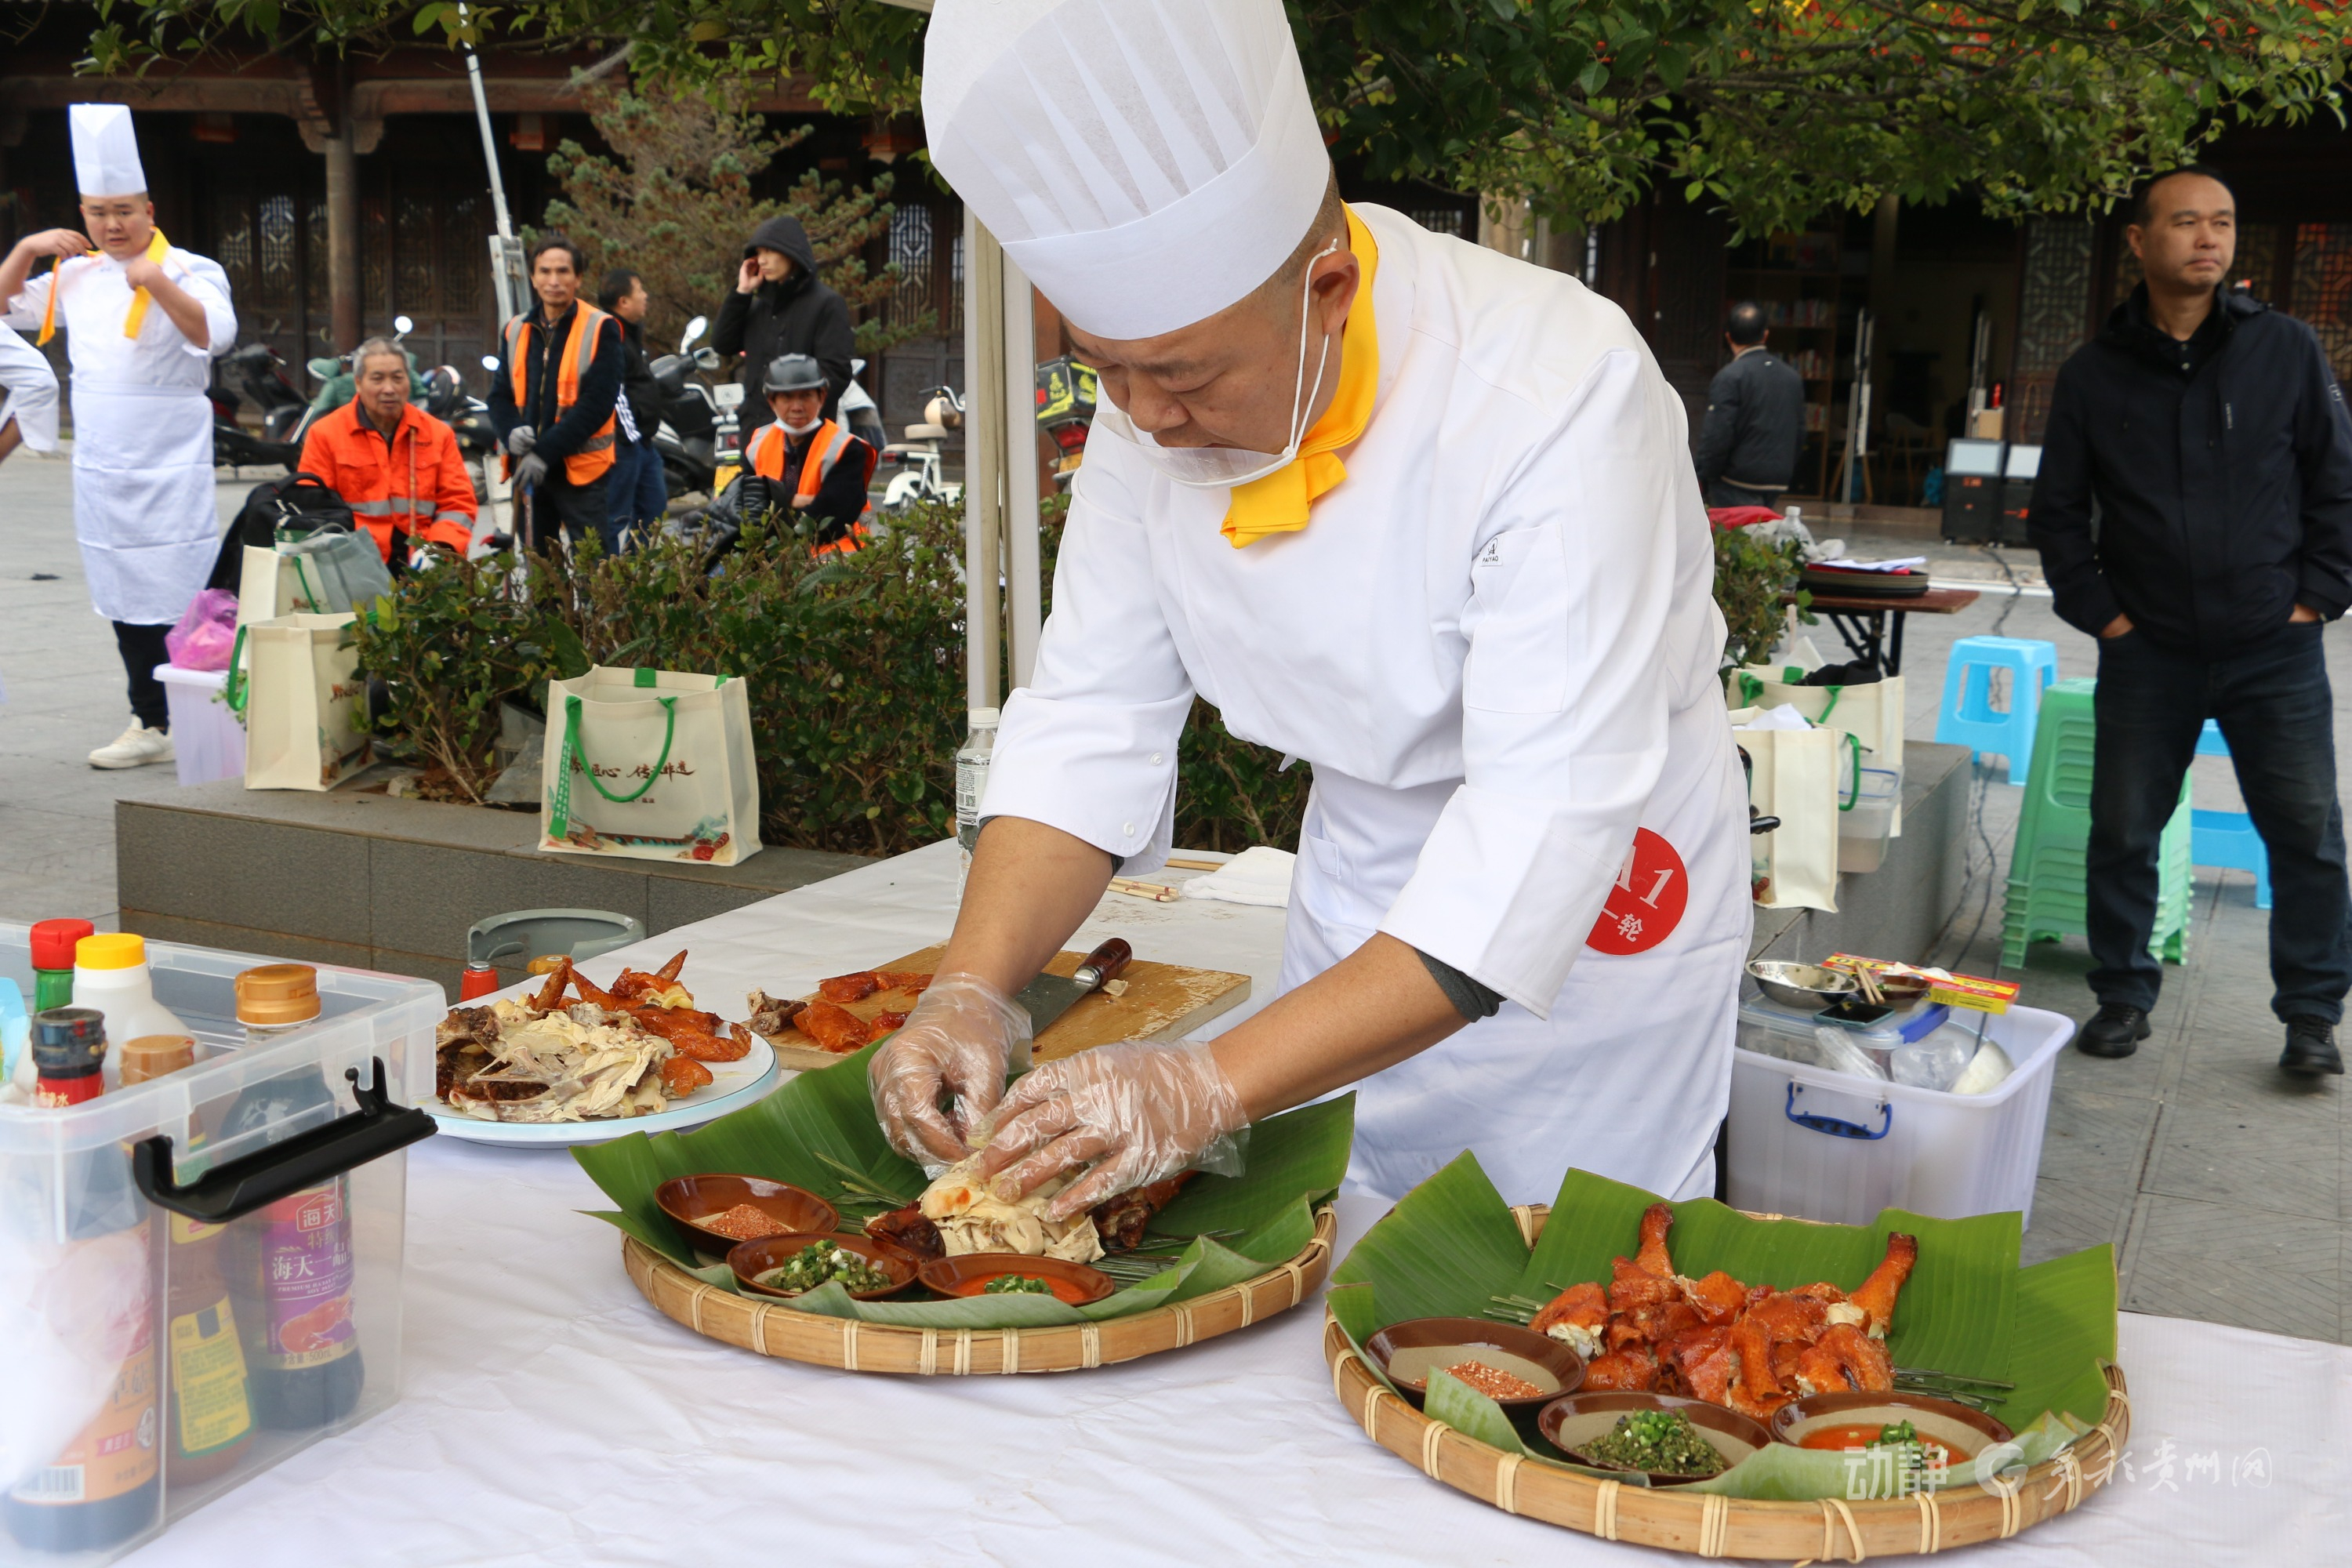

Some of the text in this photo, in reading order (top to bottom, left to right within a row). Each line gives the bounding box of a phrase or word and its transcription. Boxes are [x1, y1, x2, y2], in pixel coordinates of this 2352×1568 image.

[626, 759, 697, 782] 传非遗
[303, 1202, 336, 1229] 海天
